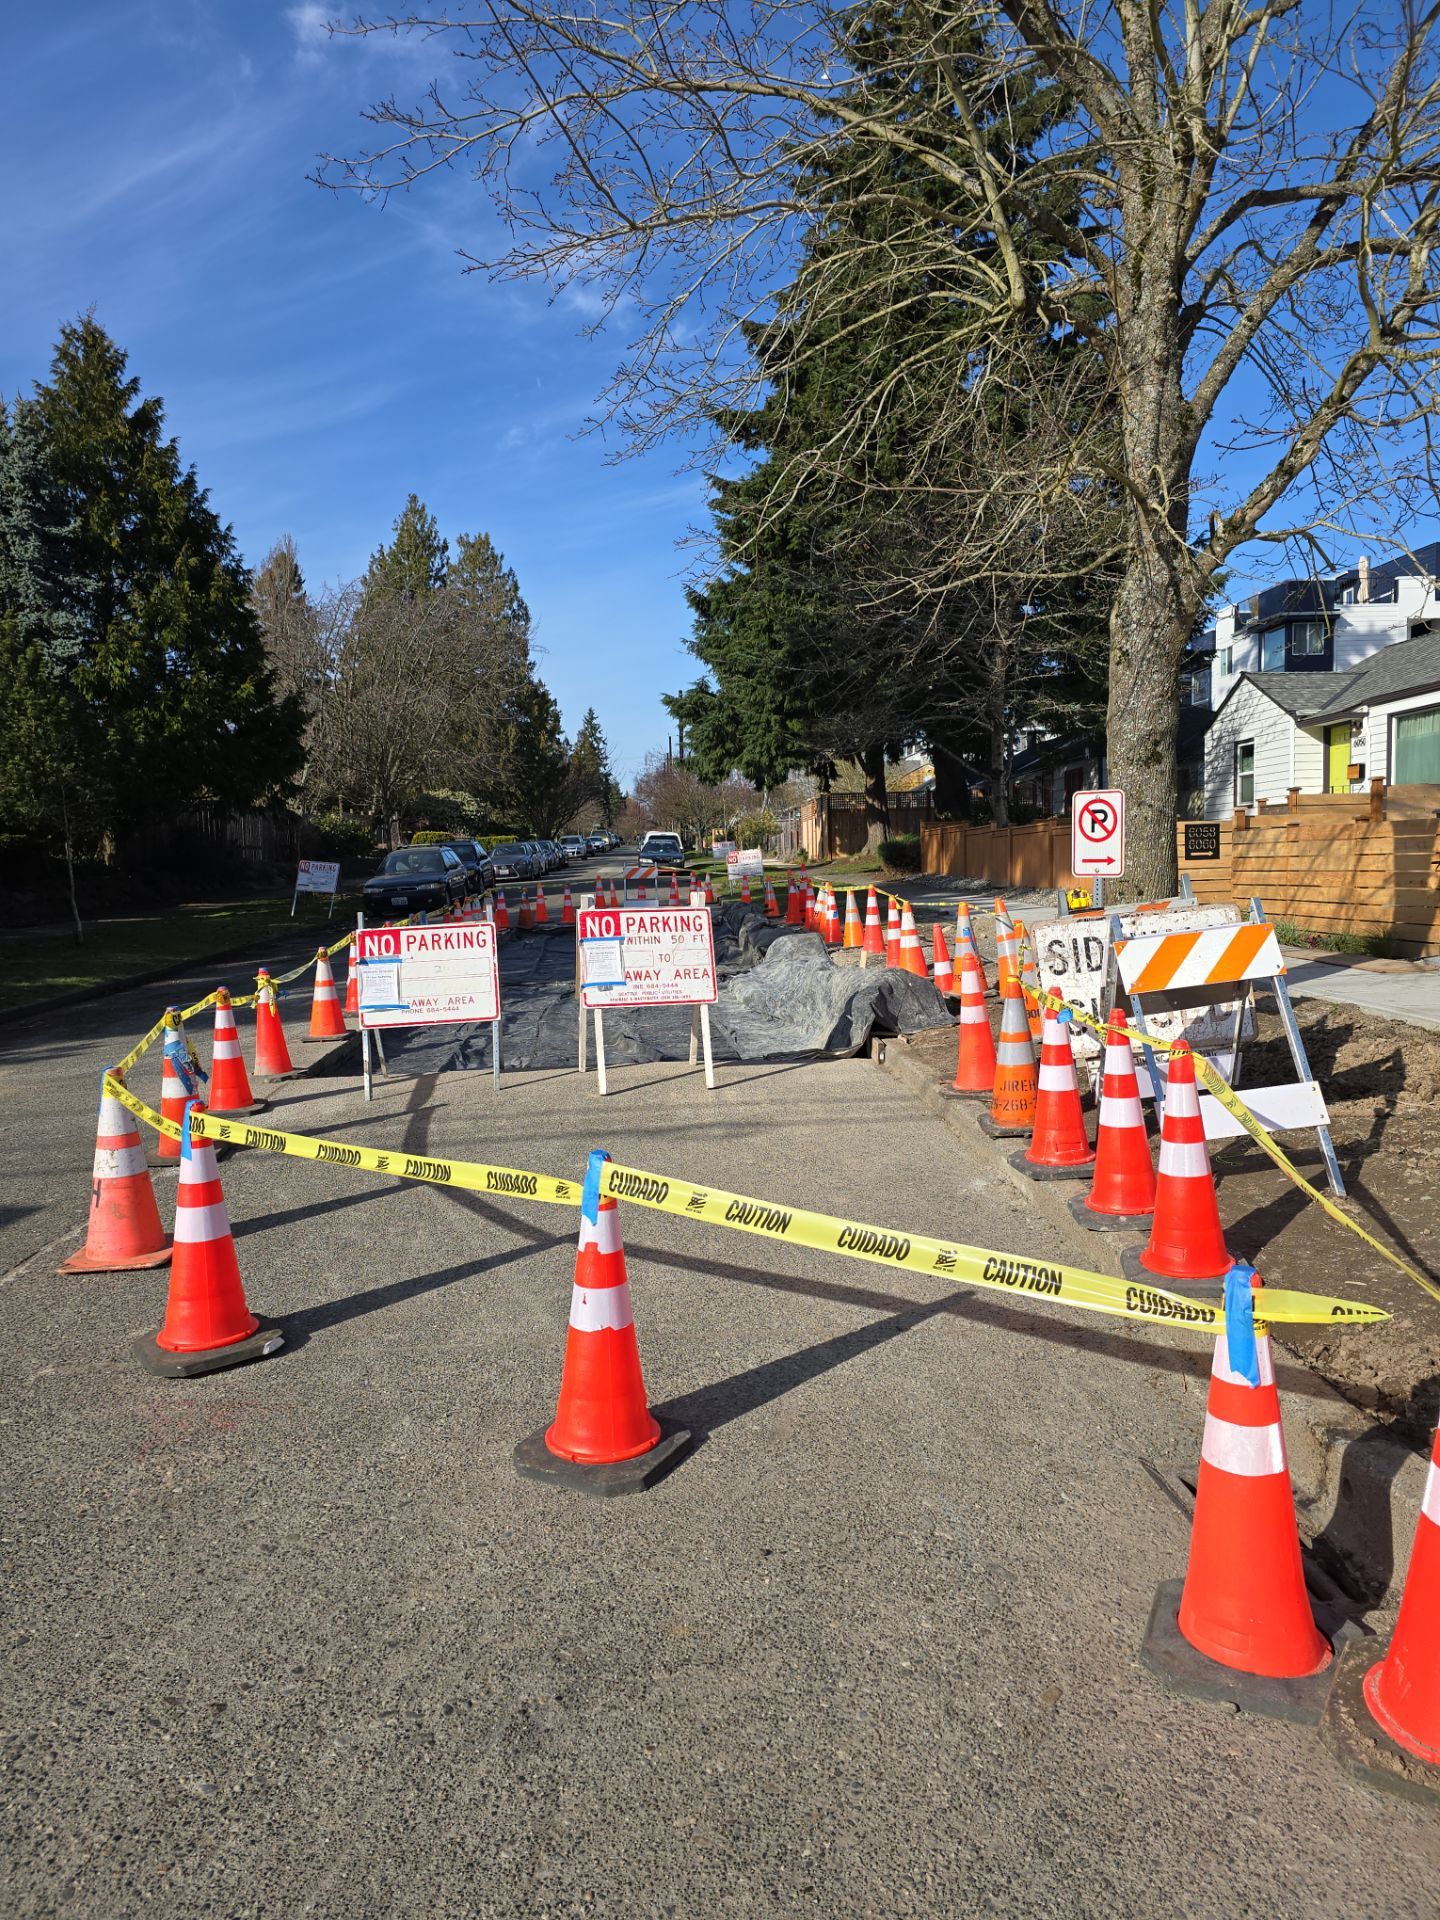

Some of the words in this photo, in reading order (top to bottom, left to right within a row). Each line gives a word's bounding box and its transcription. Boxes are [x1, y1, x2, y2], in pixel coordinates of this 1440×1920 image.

[1188, 826, 1216, 838] 6058
[1188, 838, 1216, 850] 6060
[300, 861, 310, 871] NO
[310, 863, 337, 872] PARKING
[585, 915, 615, 938] NO
[626, 915, 703, 933] PARKING
[364, 934, 395, 957] NO
[406, 931, 487, 952] PARKING
[627, 935, 661, 945] WITHIN
[671, 934, 685, 944] 50
[693, 934, 705, 943] FT
[658, 953, 671, 963] TO
[625, 969, 661, 981] AWAY
[673, 968, 711, 980] AREA
[447, 996, 475, 1006] AREA
[245, 1129, 287, 1151] CAUTION
[316, 1144, 361, 1166] CUIDADO
[404, 1159, 452, 1182] CAUTION
[486, 1171, 538, 1195] CUIDADO
[608, 1170, 669, 1204] CUIDADO
[725, 1199, 792, 1234] CAUTION
[837, 1225, 911, 1261] CUIDADO
[982, 1256, 1063, 1296] CAUTION
